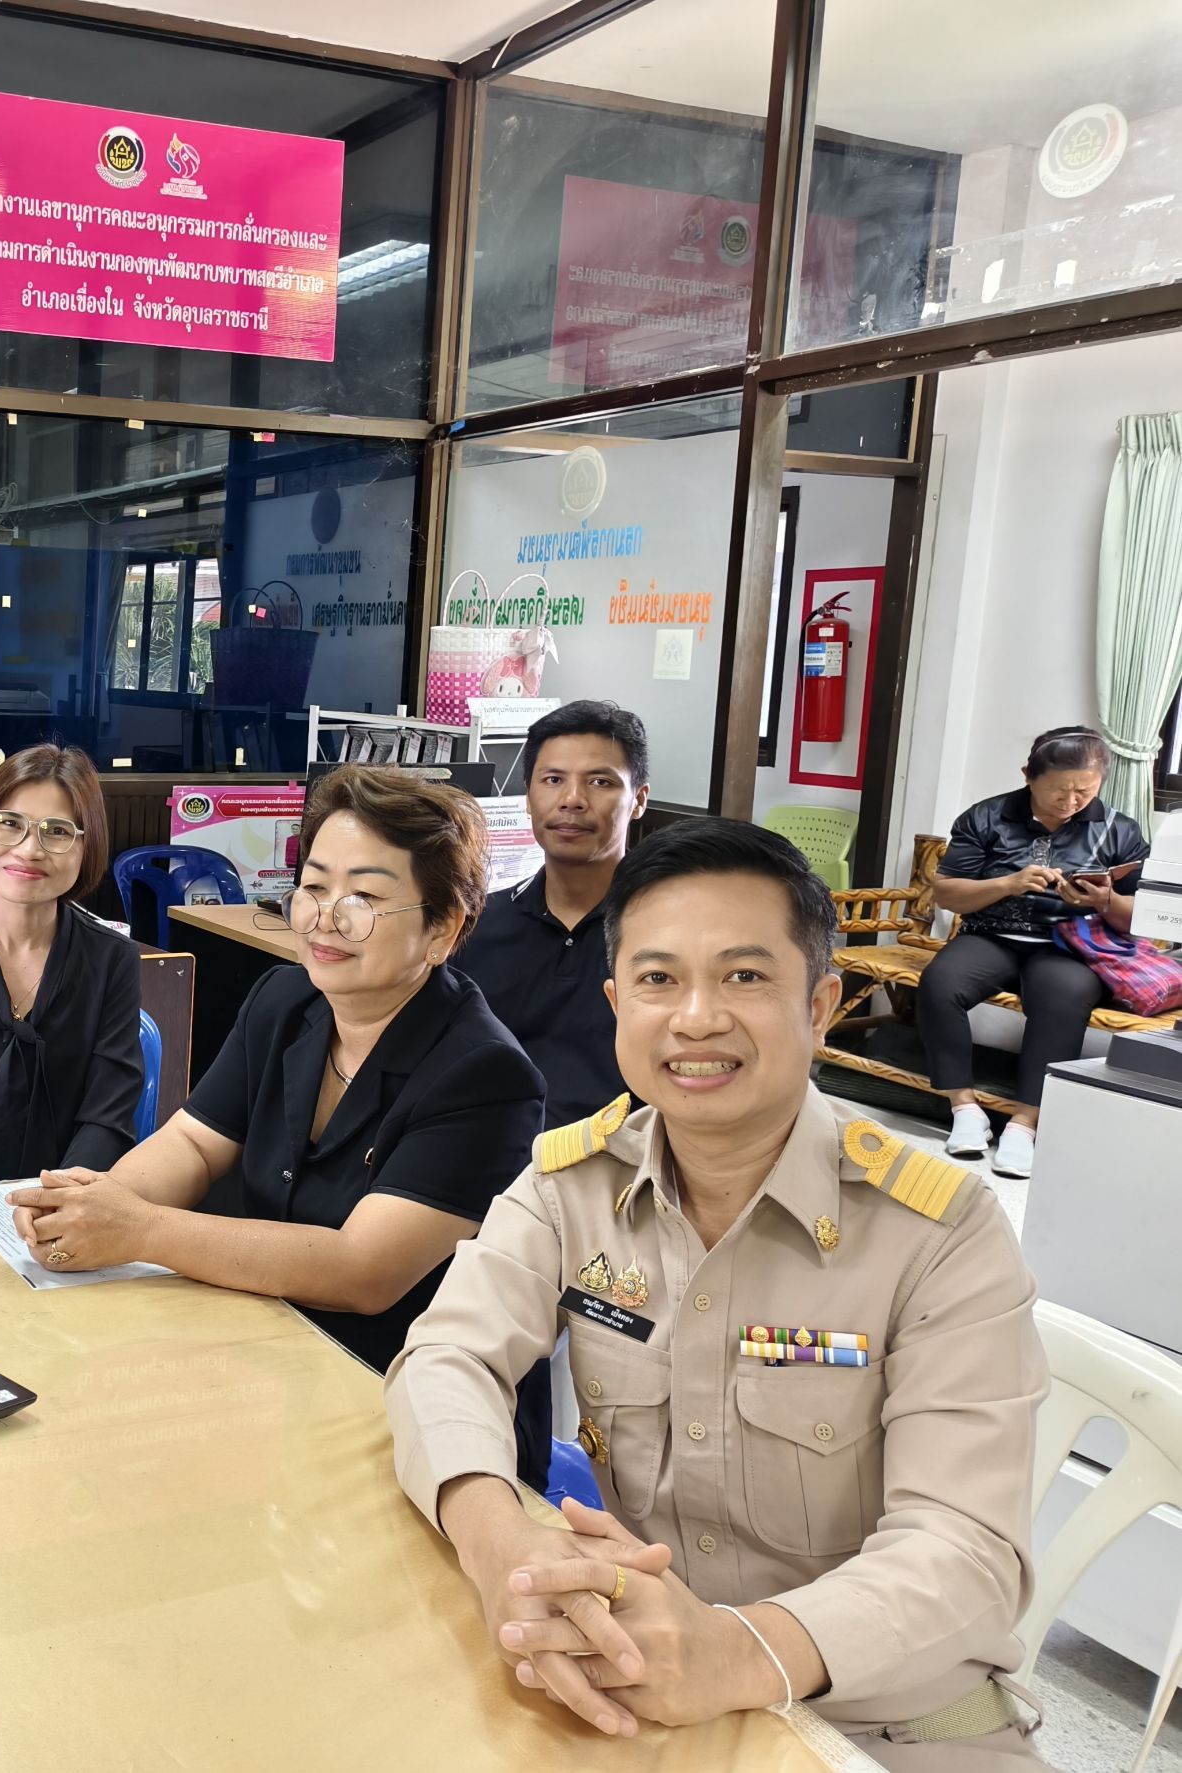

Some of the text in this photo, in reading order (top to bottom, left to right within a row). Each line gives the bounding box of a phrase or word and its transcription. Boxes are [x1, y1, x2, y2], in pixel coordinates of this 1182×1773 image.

[22, 279, 270, 333] อำเภอเขื่องใน จังหวัดอุบลราชธานี
